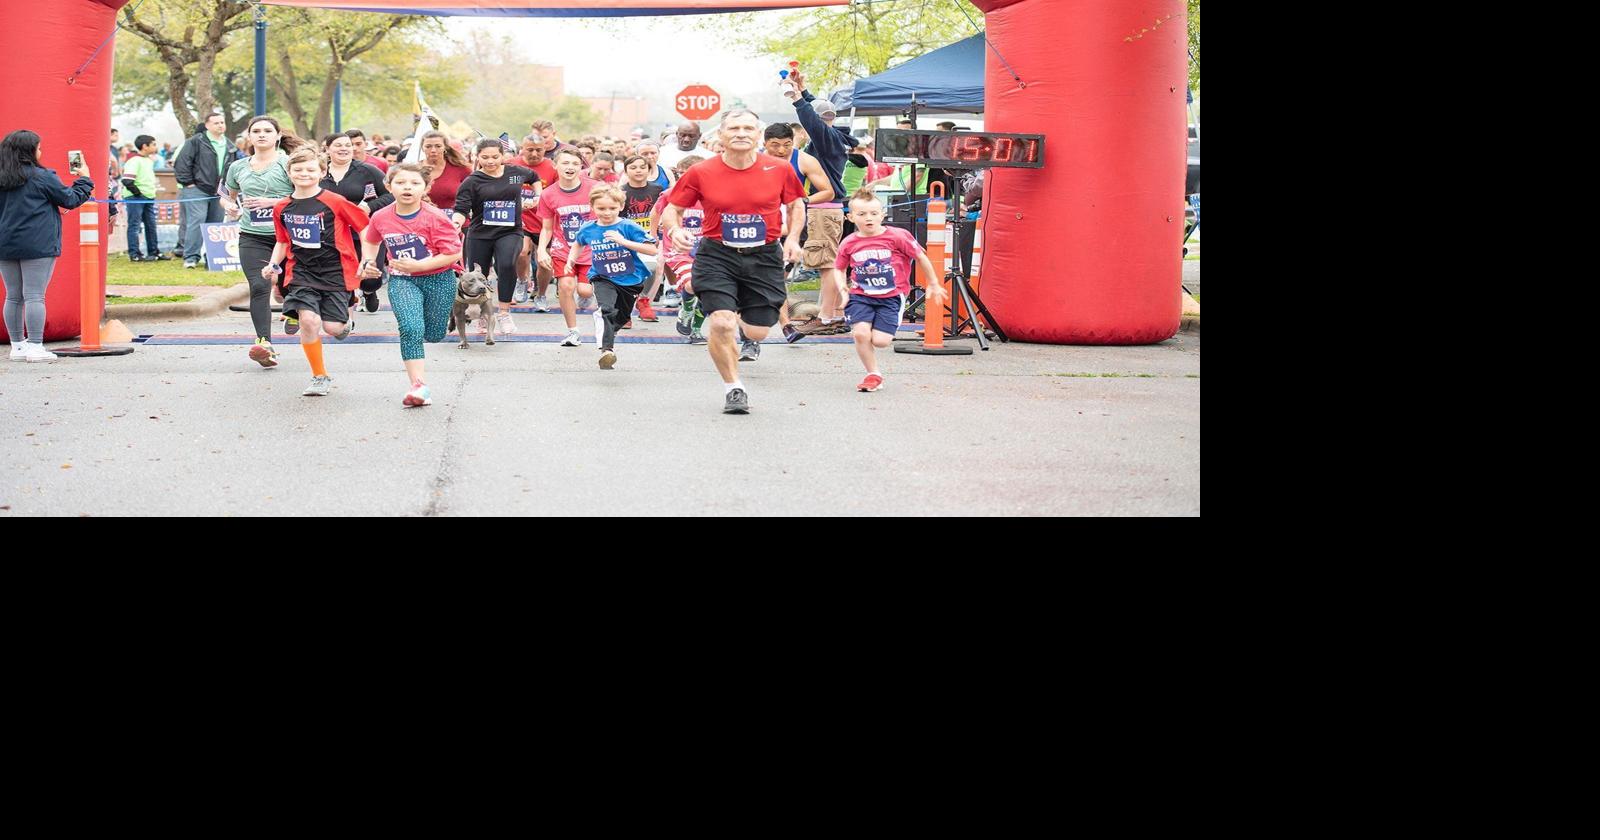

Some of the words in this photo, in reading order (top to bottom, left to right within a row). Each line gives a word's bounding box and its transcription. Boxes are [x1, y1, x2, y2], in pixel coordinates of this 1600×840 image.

[677, 95, 719, 111] STOP
[256, 208, 274, 219] 222
[207, 224, 241, 242] SM
[291, 227, 311, 240] 128
[731, 226, 758, 239] 199
[395, 246, 416, 260] 257
[591, 242, 621, 251] UTRITI
[604, 261, 627, 274] 193
[864, 276, 888, 287] 108
